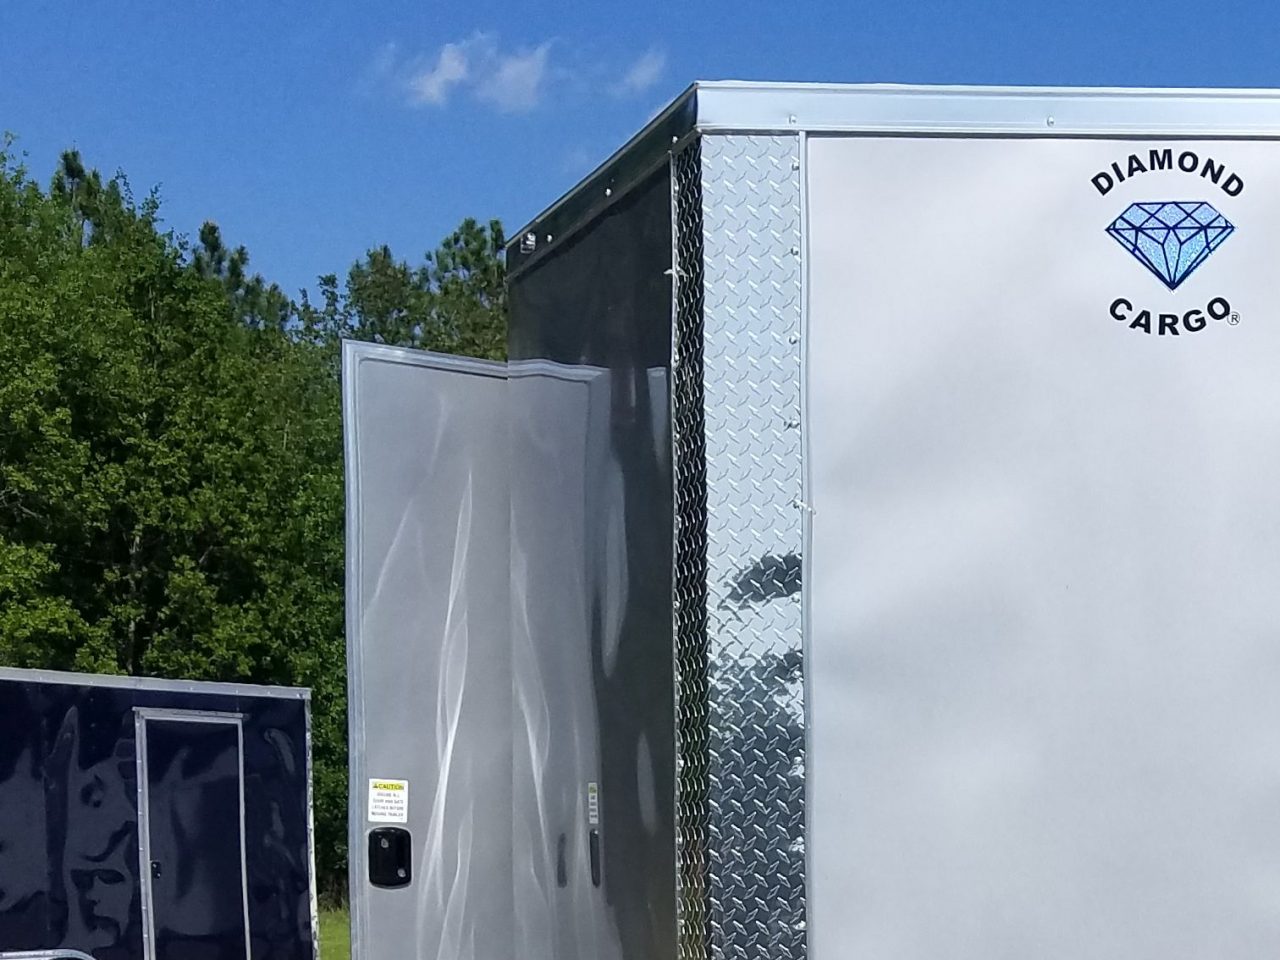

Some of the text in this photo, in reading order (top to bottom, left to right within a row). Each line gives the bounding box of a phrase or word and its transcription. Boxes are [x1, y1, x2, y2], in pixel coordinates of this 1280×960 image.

[1090, 148, 1245, 198] DIAMOND
[1109, 296, 1231, 336] CARGO
[378, 783, 405, 791] CAUTION
